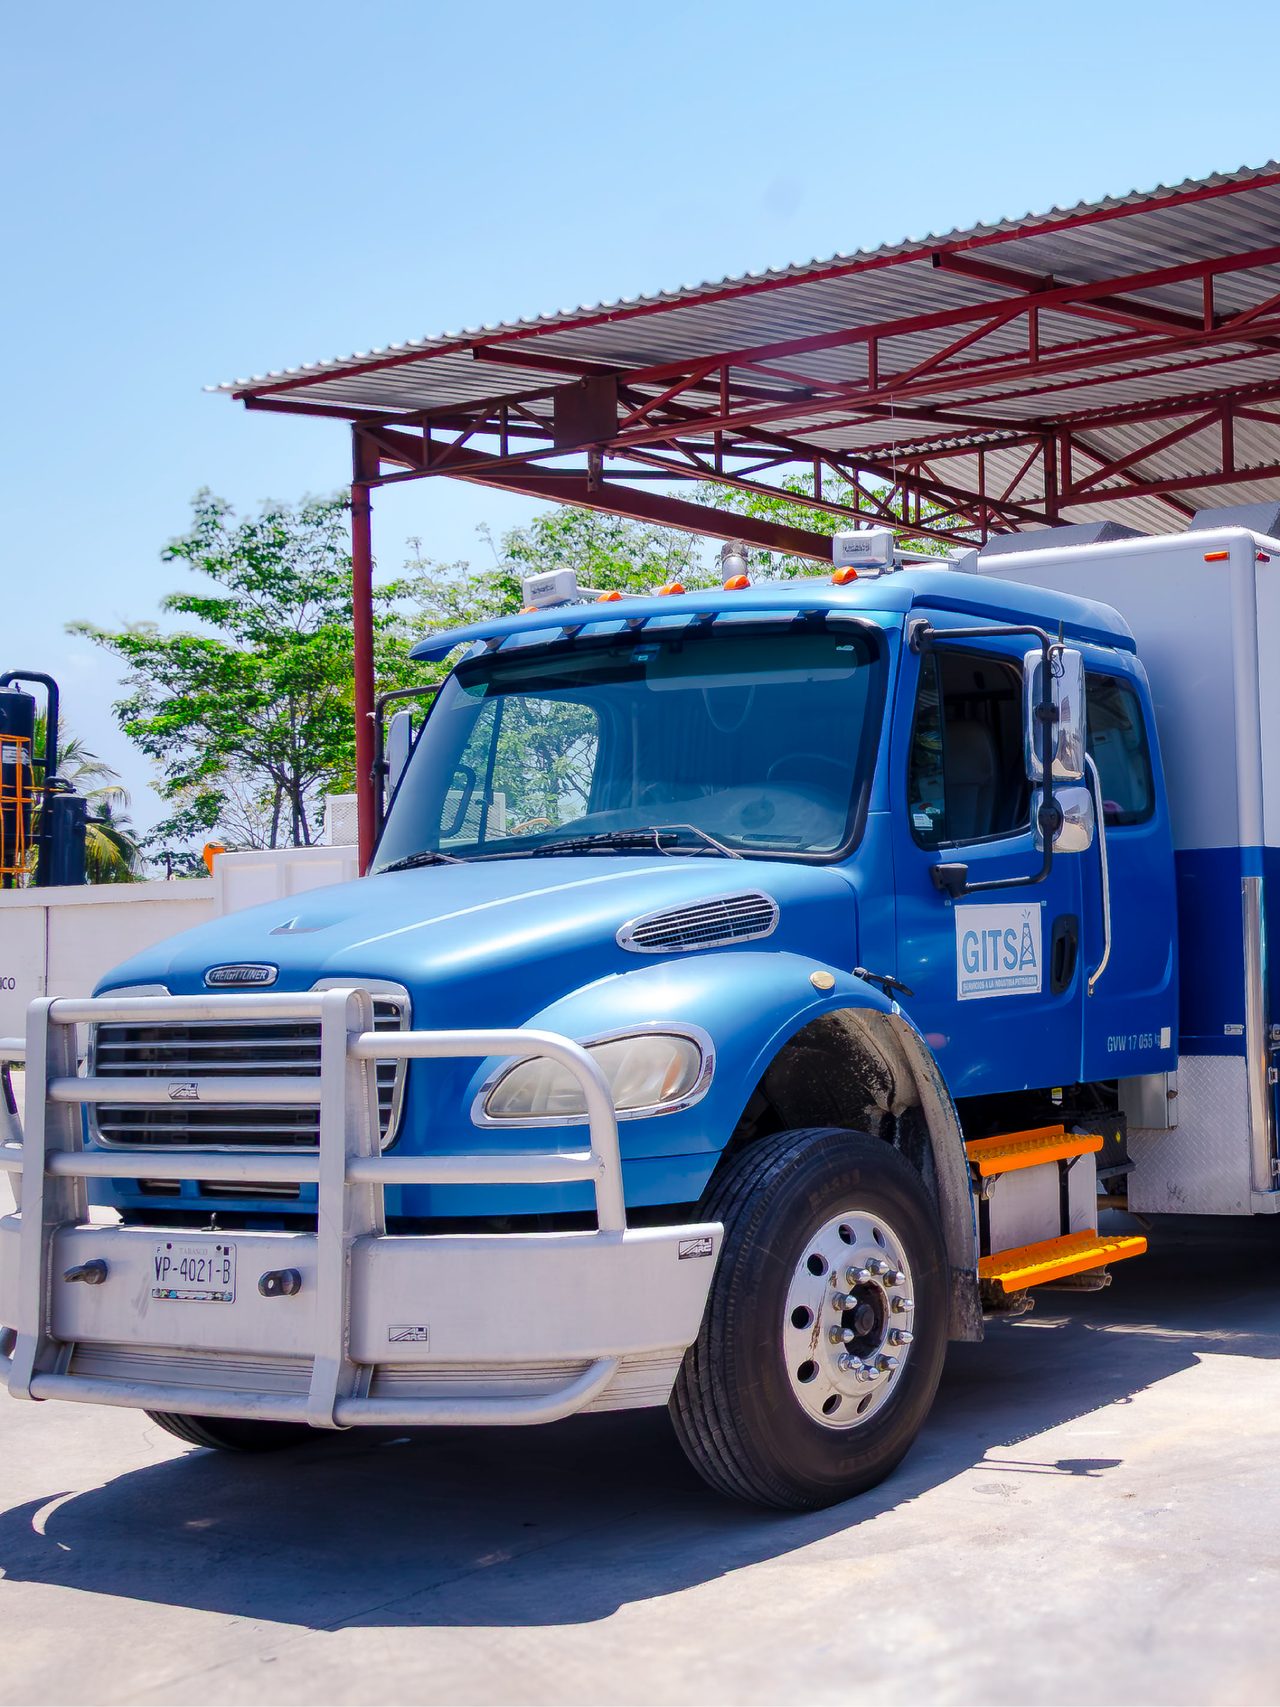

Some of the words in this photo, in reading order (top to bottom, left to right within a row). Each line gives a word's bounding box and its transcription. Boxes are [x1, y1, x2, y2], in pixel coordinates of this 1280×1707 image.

[962, 922, 1037, 974] GITSA
[210, 968, 268, 981] FREIGHTLINER
[1107, 1035, 1127, 1052] GVW
[1128, 1034, 1137, 1051] 17
[1138, 1033, 1153, 1050] 055
[178, 1247, 209, 1256] TABASCO
[154, 1256, 231, 1284] VP-4021-B
